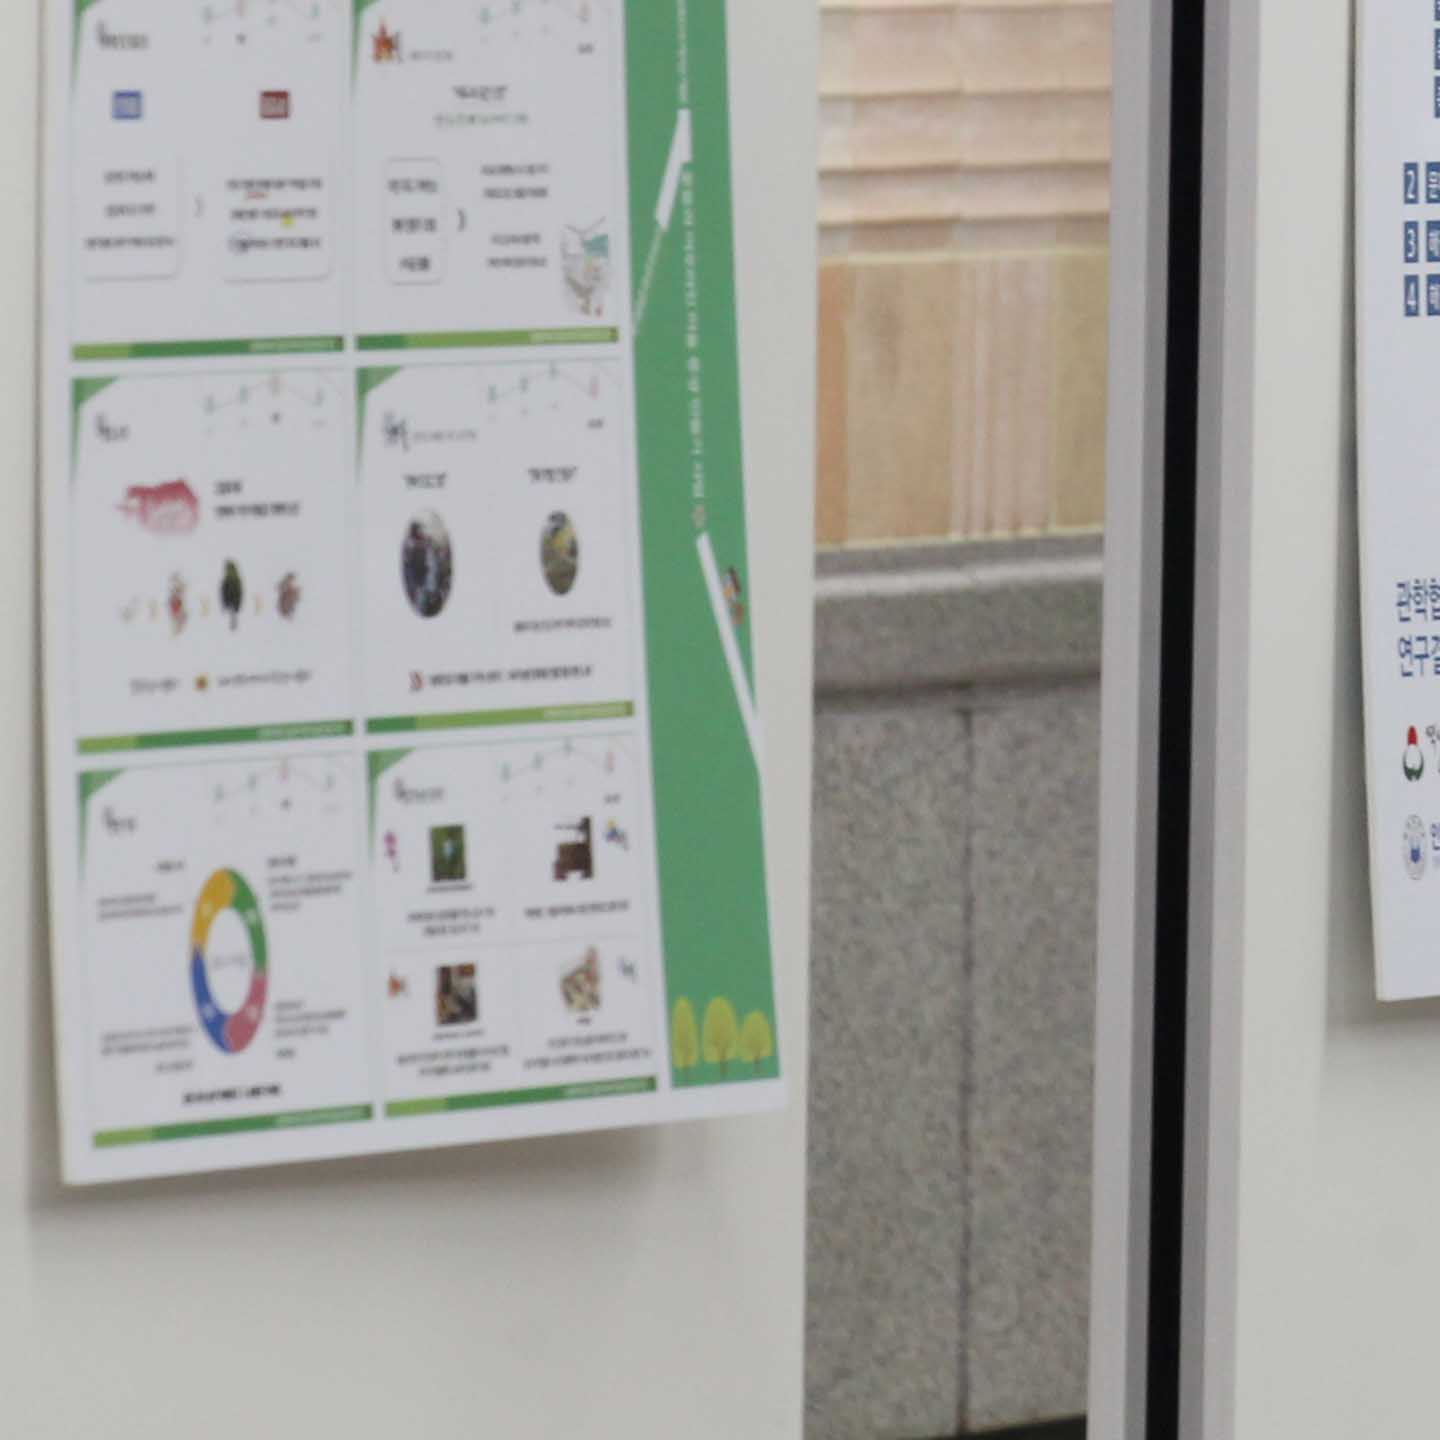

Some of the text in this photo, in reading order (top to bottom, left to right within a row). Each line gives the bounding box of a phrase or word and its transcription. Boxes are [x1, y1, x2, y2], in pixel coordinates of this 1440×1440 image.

[1406, 170, 1415, 200] 2
[1406, 228, 1416, 258] 3
[1406, 282, 1416, 312] 4
